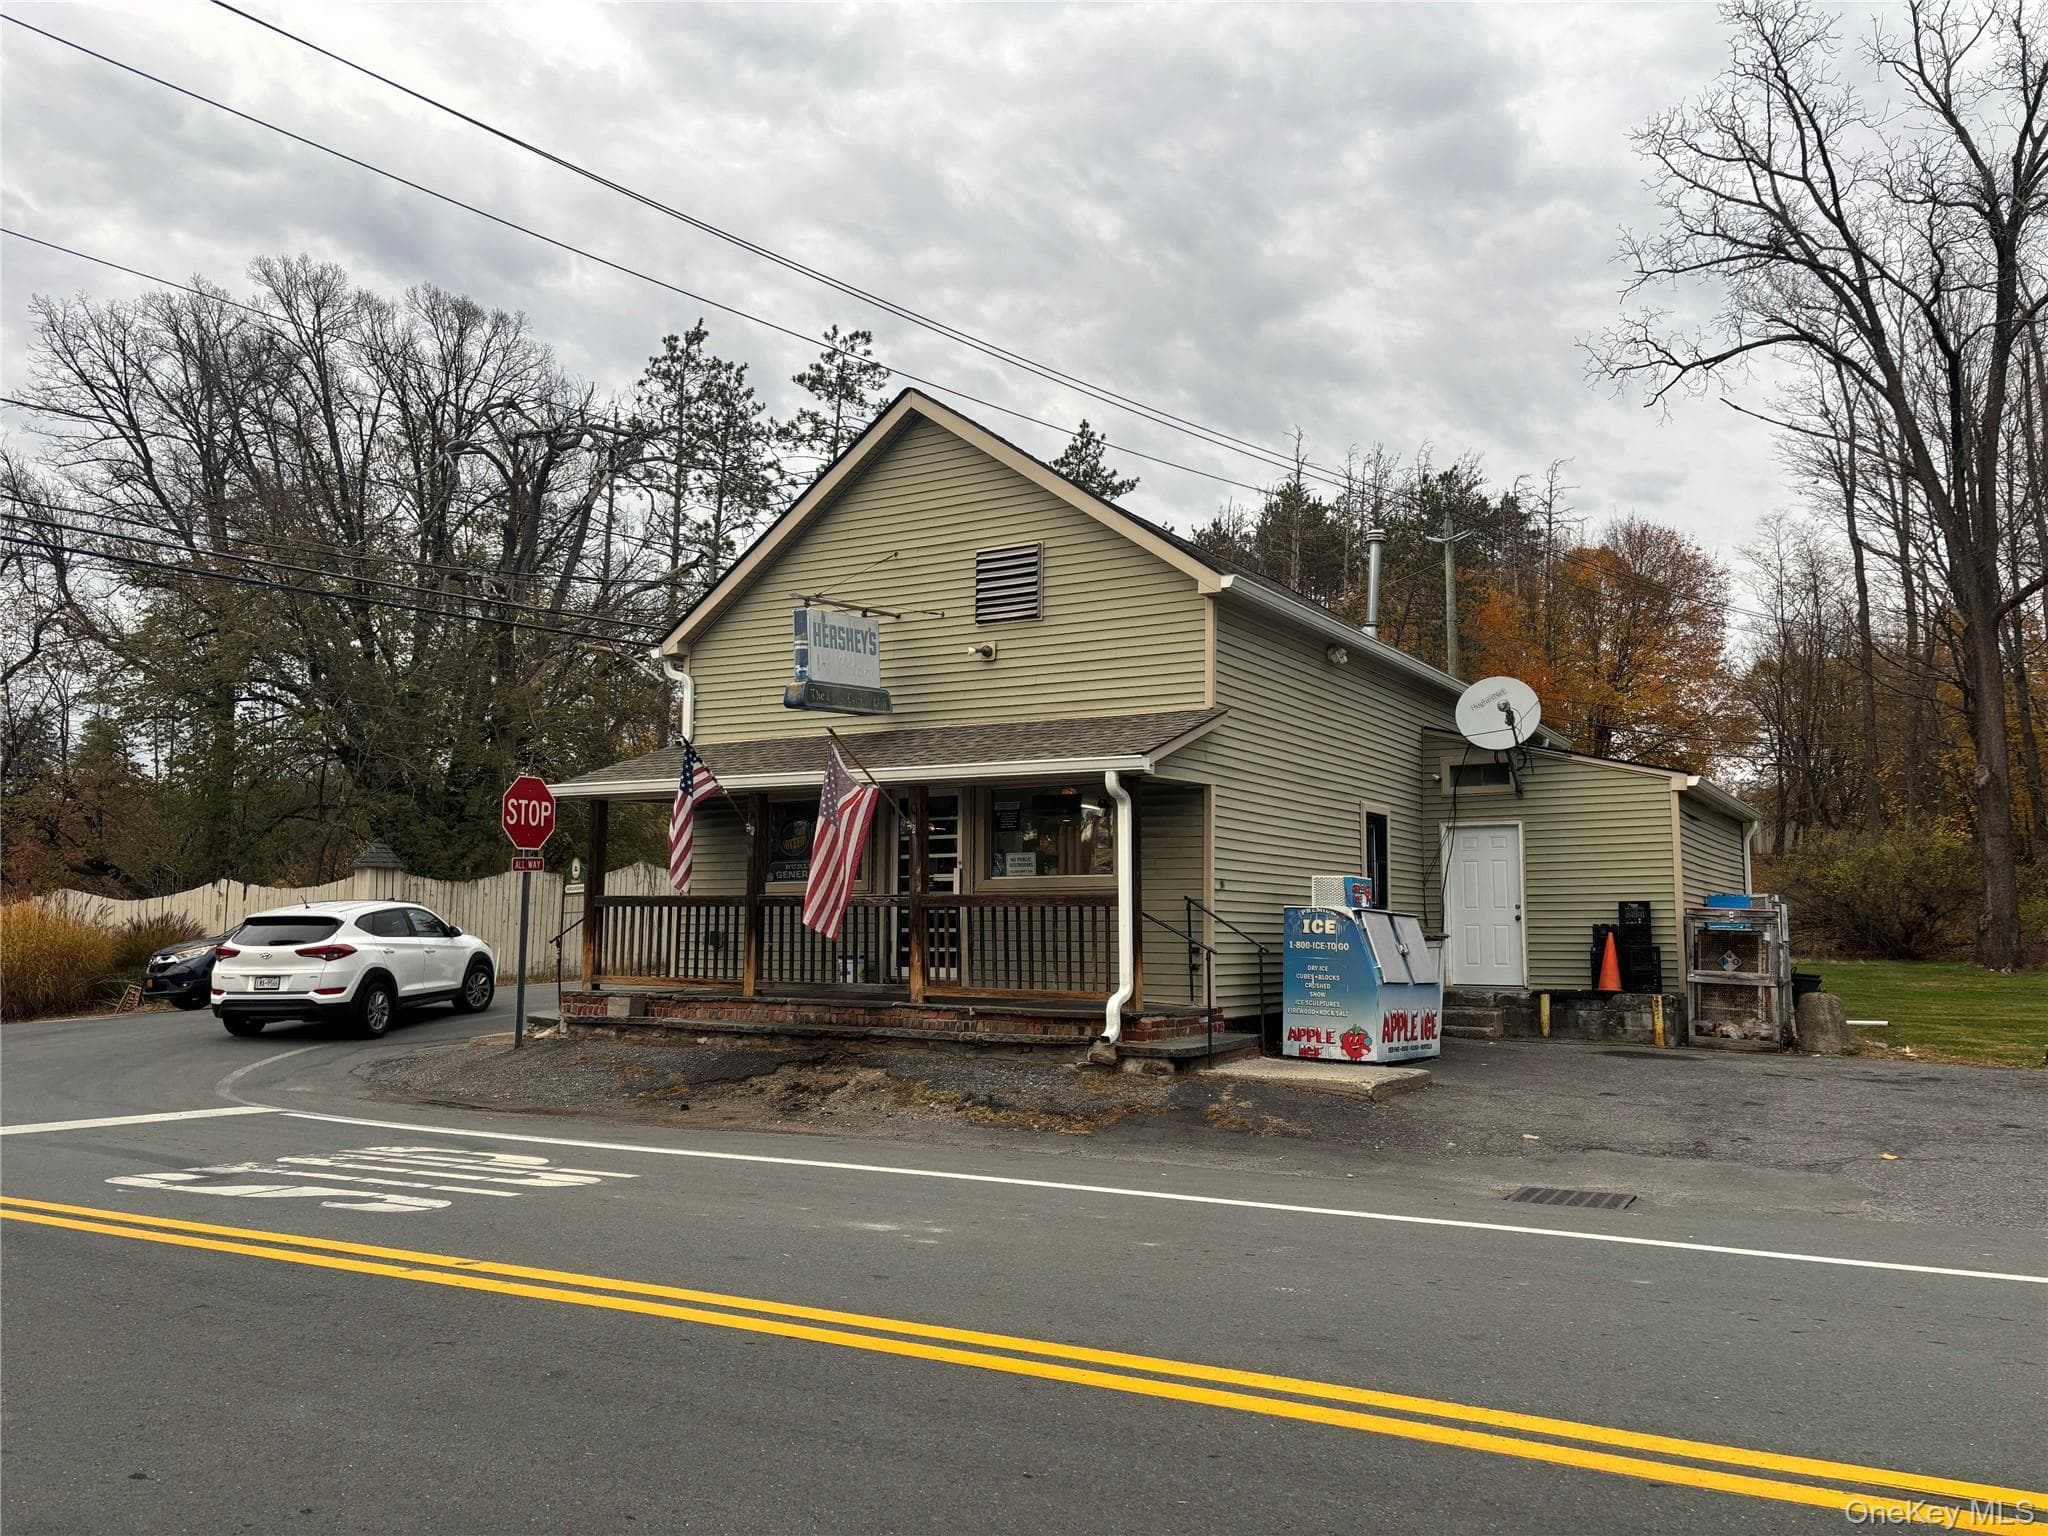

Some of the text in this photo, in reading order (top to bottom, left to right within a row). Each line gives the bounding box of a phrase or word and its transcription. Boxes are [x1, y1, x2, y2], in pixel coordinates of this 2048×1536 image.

[813, 621, 877, 656] HERSHEY'S
[506, 798, 552, 827] STOP
[514, 861, 541, 869] ALL WAY
[776, 870, 809, 879] GENER
[1302, 919, 1336, 935] ICE
[1288, 940, 1350, 951] 1-800-ICE-TOGO
[1382, 1007, 1438, 1043] APPLE ICE
[1287, 1026, 1336, 1044] APPLE
[104, 1145, 642, 1213] STOP
